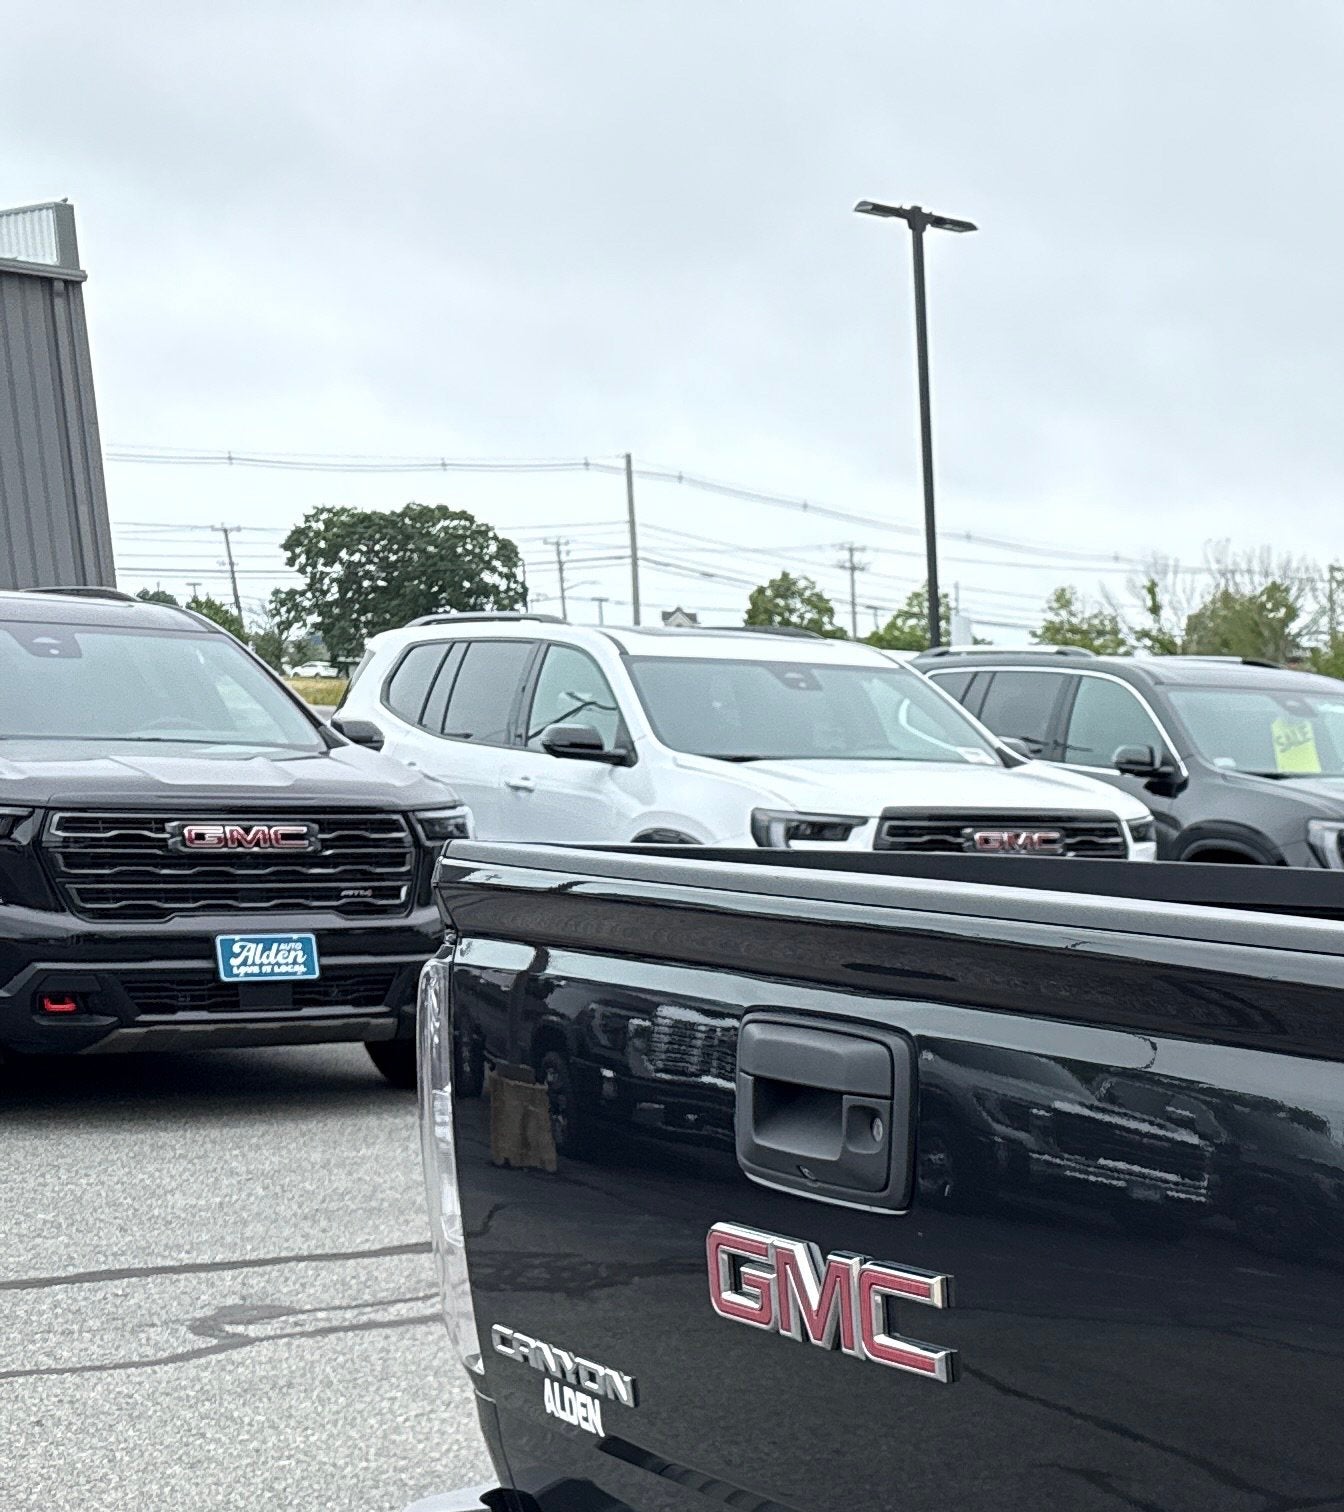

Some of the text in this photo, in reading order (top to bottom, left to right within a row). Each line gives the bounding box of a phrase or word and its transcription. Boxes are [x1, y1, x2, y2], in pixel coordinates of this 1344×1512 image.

[183, 825, 309, 848] GMC
[974, 831, 1061, 851] GMC
[229, 942, 307, 966] Alden
[279, 942, 303, 950] AUTO
[706, 1221, 956, 1384] GMC
[491, 1323, 639, 1408] CANYON
[543, 1377, 606, 1438] ALDEN
